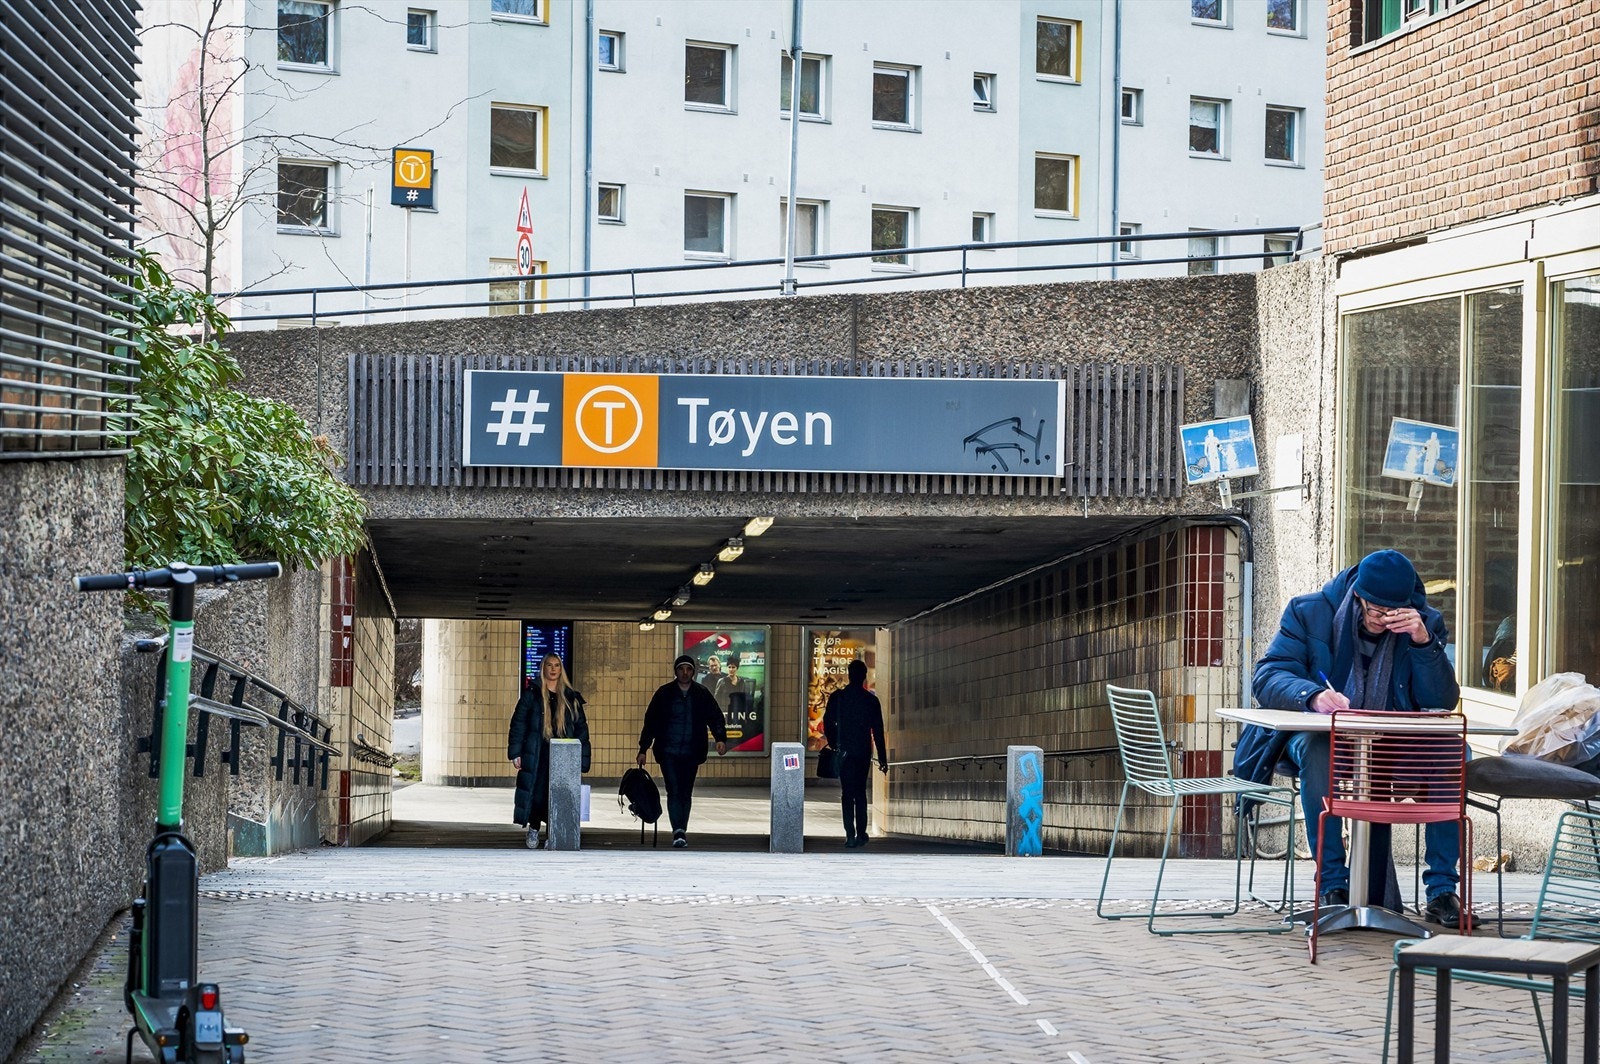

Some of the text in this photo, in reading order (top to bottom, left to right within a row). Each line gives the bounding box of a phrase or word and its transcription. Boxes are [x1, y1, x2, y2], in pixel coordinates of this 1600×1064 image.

[520, 246, 530, 268] 30
[677, 398, 833, 457] Tøyen
[813, 637, 842, 646] GJØR
[813, 657, 829, 665] TIL
[723, 711, 757, 721] TING
